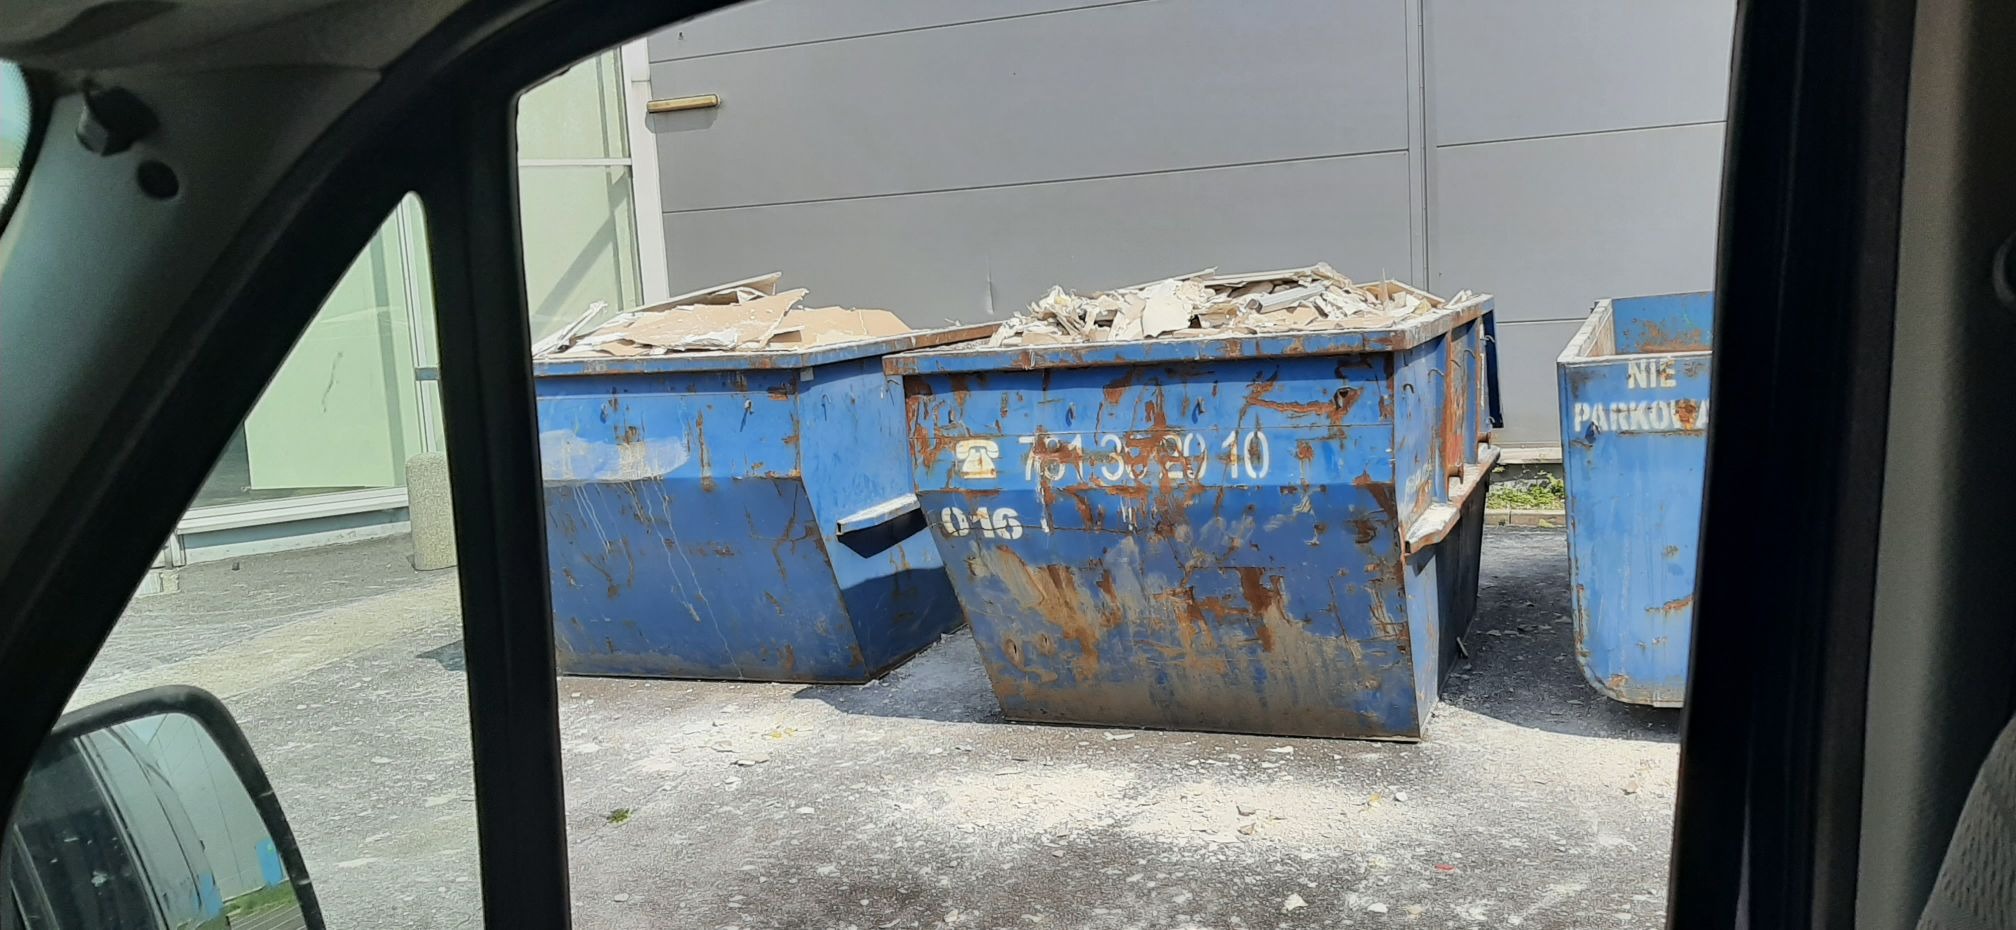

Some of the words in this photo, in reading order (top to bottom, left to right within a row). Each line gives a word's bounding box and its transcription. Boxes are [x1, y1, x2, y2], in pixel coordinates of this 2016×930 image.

[1627, 357, 1677, 389] NIE
[1221, 429, 1270, 480] 10
[940, 506, 1024, 540] 016
